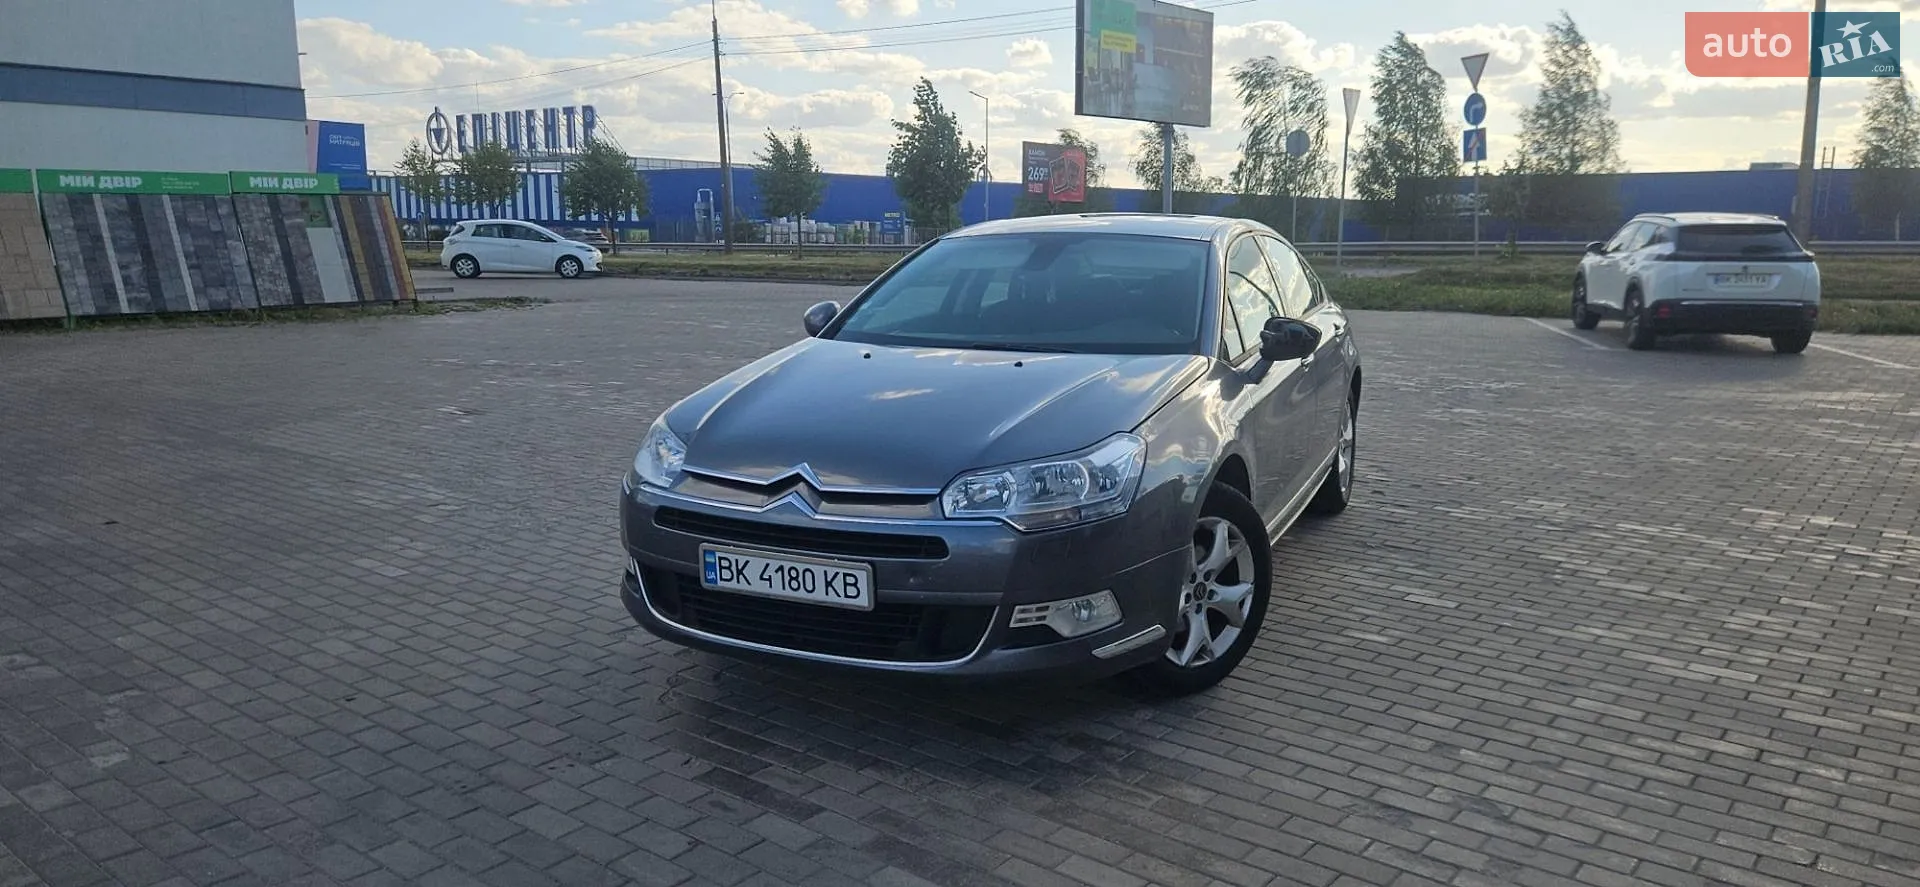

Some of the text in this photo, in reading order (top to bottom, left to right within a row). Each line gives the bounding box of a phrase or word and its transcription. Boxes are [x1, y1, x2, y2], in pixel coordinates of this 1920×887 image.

[456, 100, 597, 153] ЕПІЦЕНТР
[59, 173, 142, 189] МІЙ ДВІР
[249, 174, 279, 188] МІЙ
[281, 177, 318, 190] ДВІР
[706, 570, 716, 581] UA
[718, 556, 861, 600] BK 4180 KB
